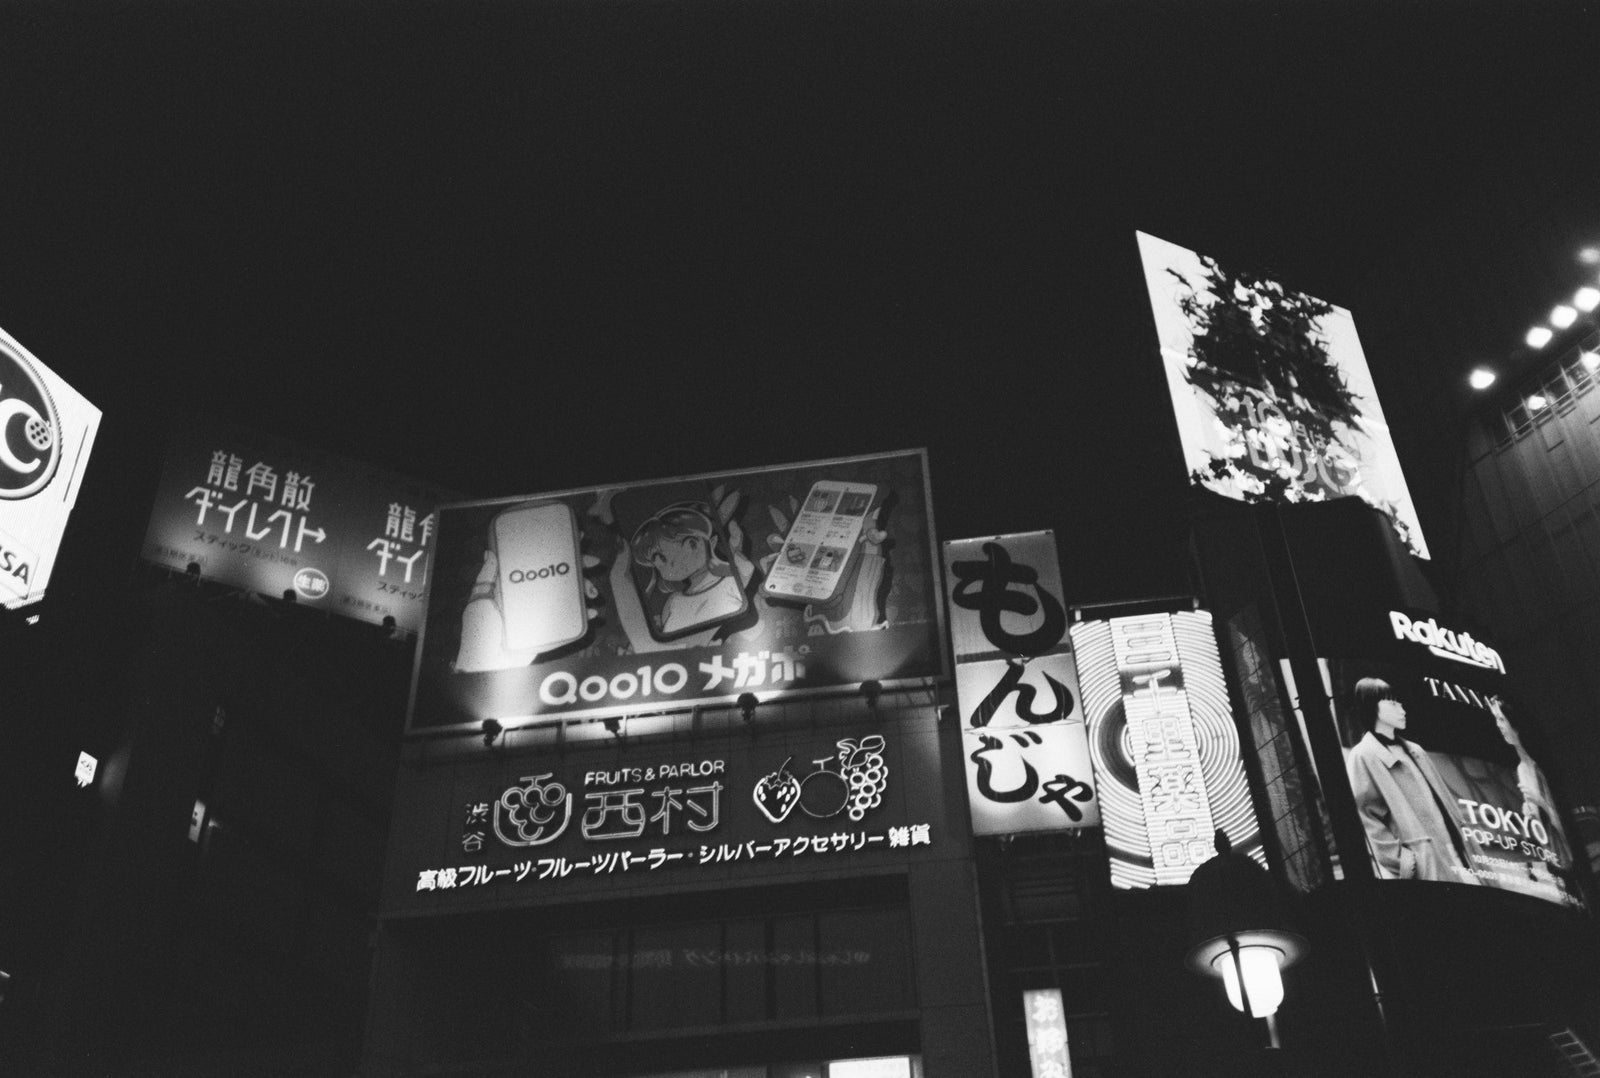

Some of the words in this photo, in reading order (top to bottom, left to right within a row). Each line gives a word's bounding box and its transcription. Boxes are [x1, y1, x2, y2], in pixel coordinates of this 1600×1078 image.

[207, 450, 315, 511] 龍角散
[185, 486, 326, 552] ダイレクト
[367, 538, 429, 586] ダイ
[509, 562, 570, 583] Qoo10
[1389, 610, 1506, 675] Rakuten
[539, 662, 688, 705] Qoo10
[951, 542, 1093, 822] もんじゃ
[584, 768, 642, 786] FRUITS
[644, 766, 656, 781] &
[659, 760, 725, 779] PARLOR
[461, 802, 489, 852] 渋谷
[581, 780, 724, 841] 西村
[1458, 798, 1548, 845] TOKYO
[1461, 827, 1518, 851] POP-UP
